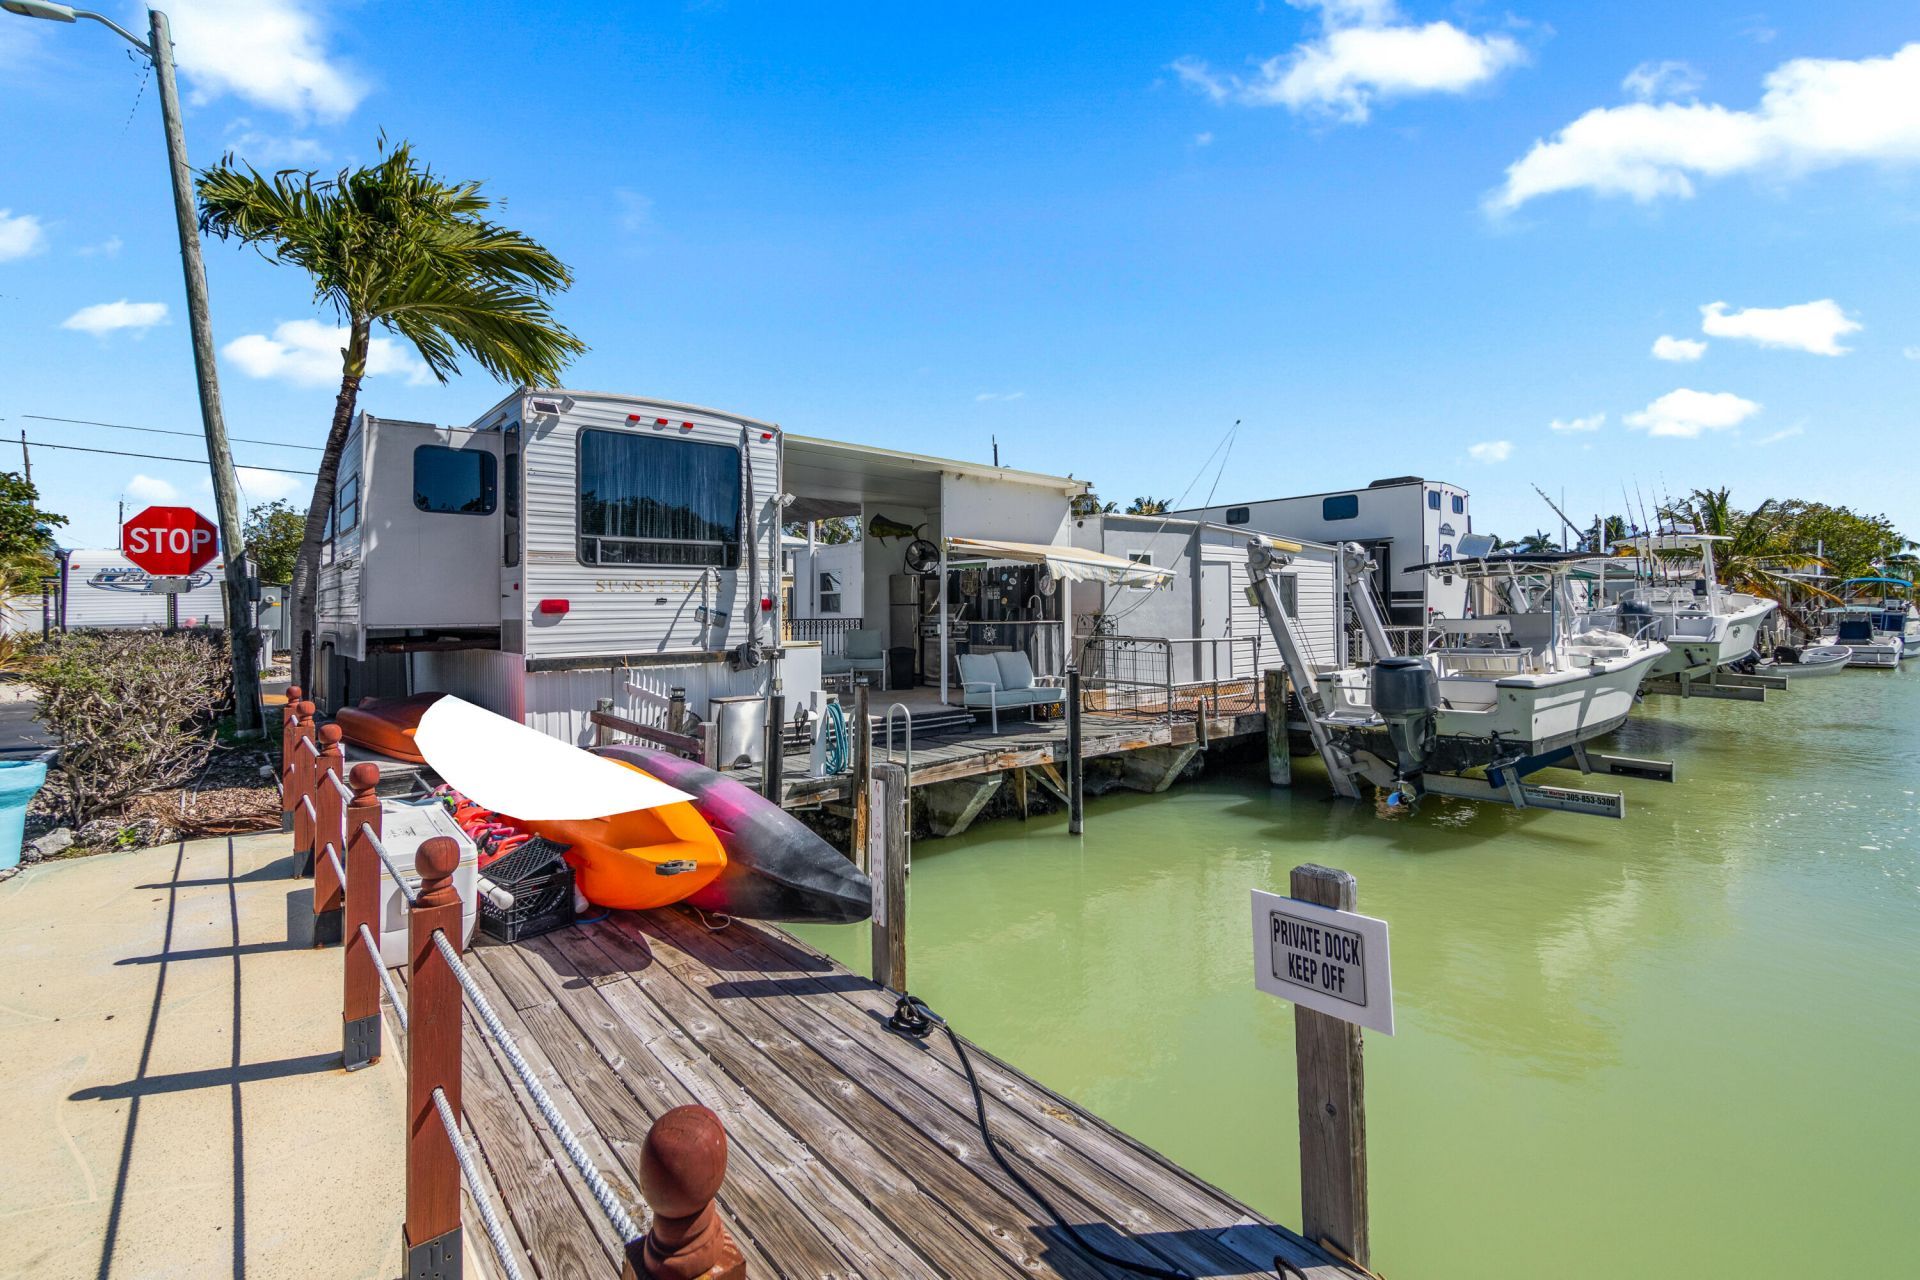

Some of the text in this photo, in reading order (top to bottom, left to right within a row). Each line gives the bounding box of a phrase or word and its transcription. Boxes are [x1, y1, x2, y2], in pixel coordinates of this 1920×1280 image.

[129, 528, 211, 554] STOP
[1566, 793, 1615, 806] 305-853-5300
[1273, 917, 1361, 967] PRIVATE DOCK
[1287, 951, 1345, 993] KEEP OFF
